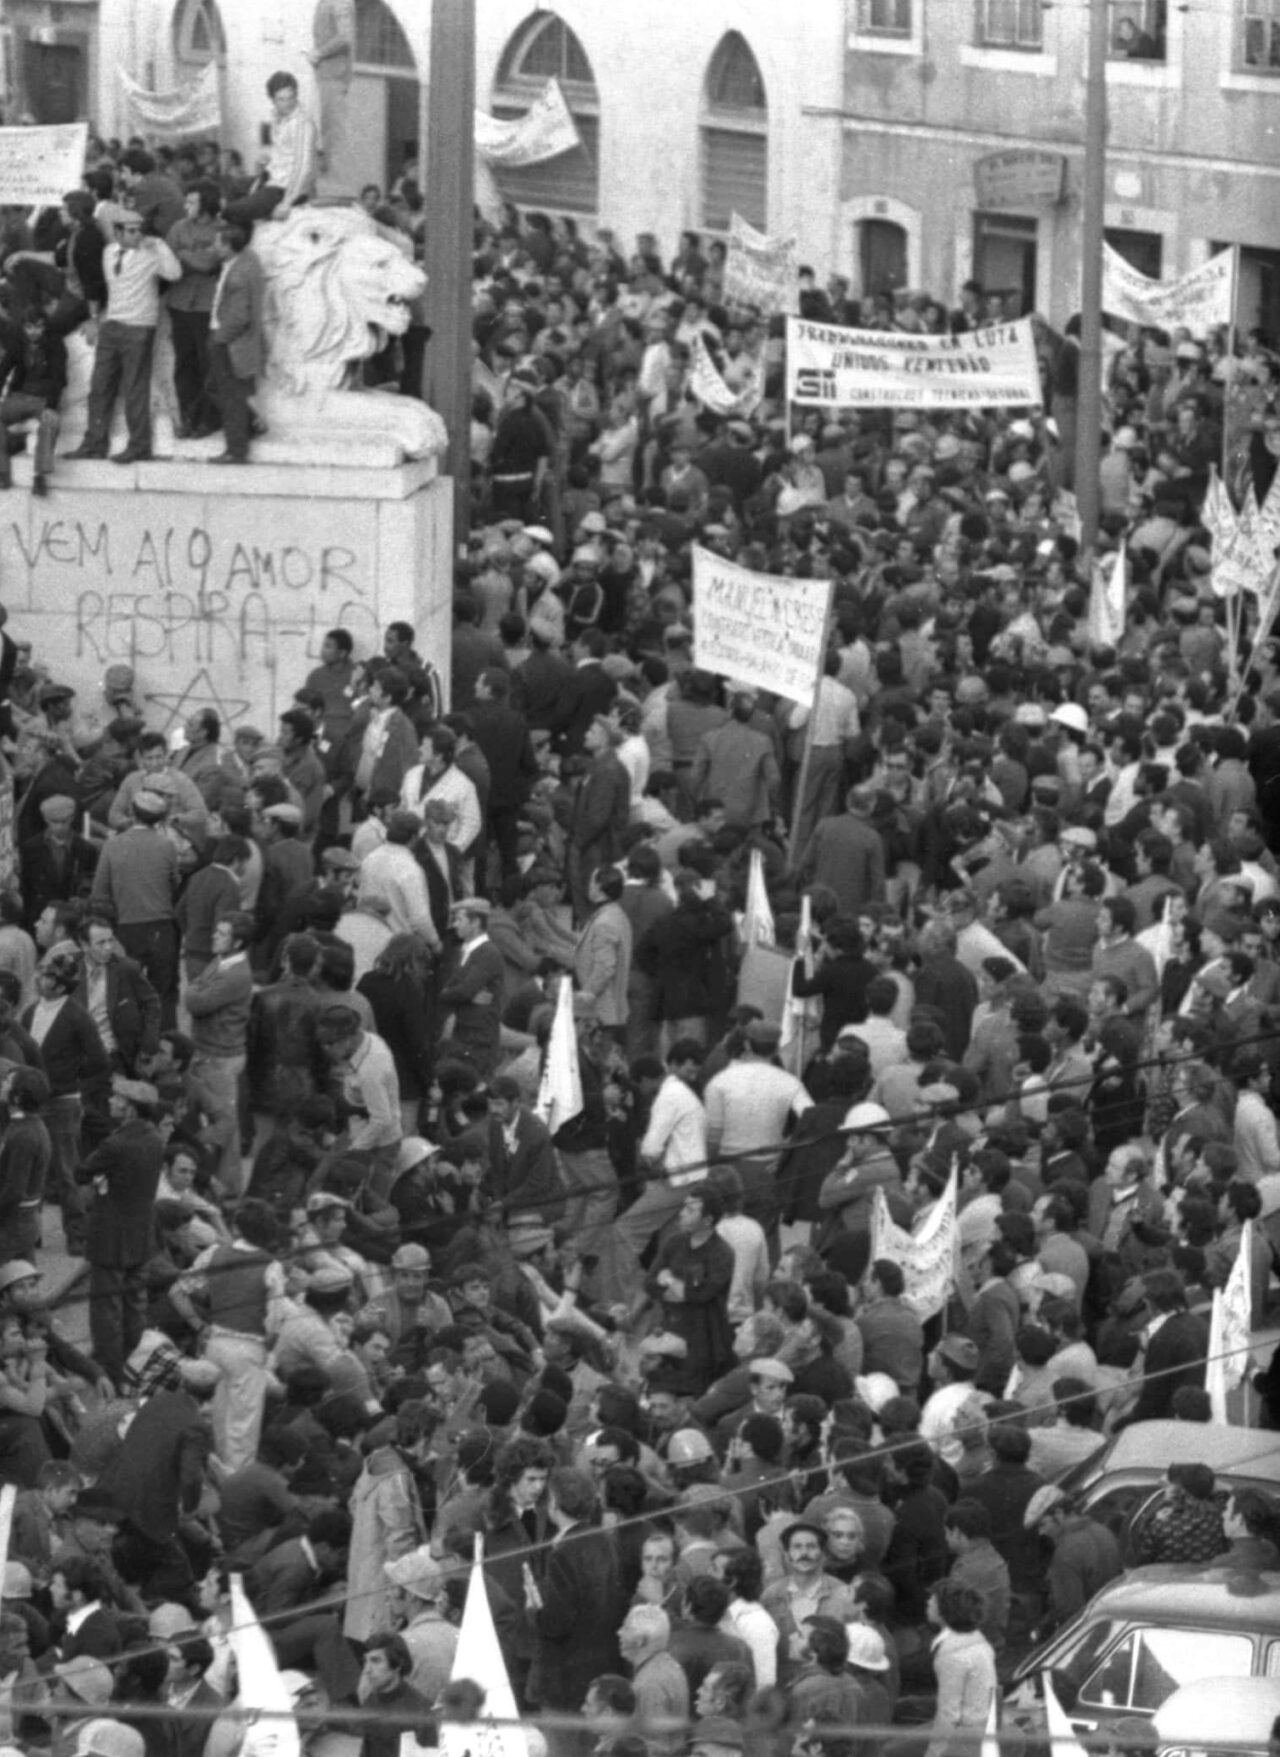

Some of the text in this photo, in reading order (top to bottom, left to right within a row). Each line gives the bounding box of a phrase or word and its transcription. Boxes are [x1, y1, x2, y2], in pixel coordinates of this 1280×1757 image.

[974, 327, 1019, 348] LUTA
[831, 352, 890, 372] UNIDOS
[12, 521, 112, 575] VEM
[226, 542, 365, 595] AMOR
